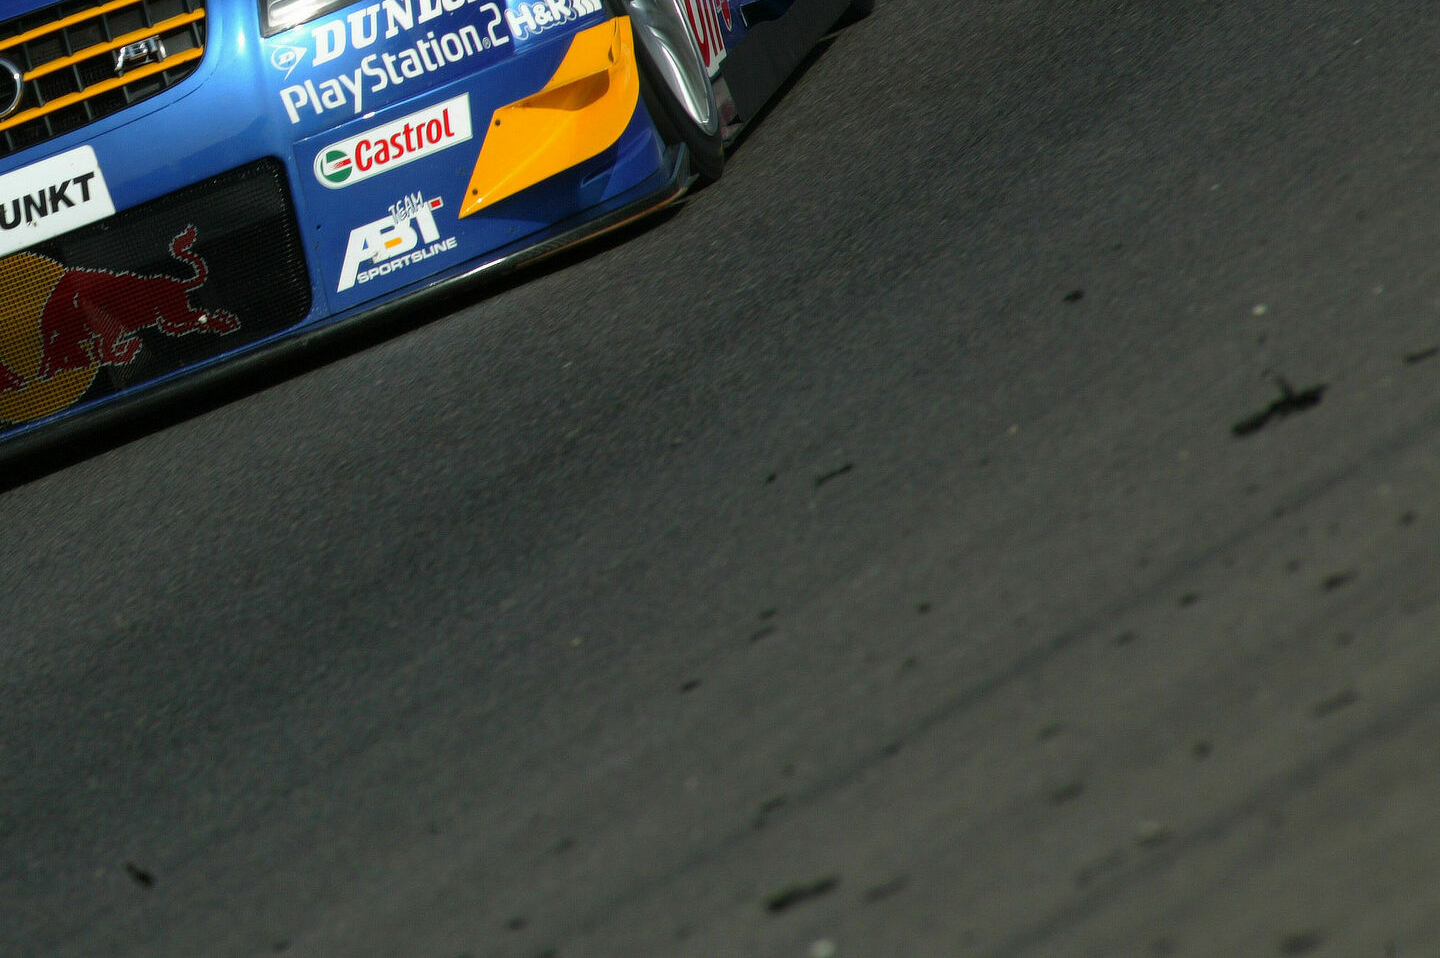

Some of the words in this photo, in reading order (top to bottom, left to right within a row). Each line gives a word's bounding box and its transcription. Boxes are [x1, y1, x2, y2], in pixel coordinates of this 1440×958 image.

[355, 107, 455, 172] Castrol
[388, 190, 424, 223] TEAM
[337, 195, 444, 293] ABT
[357, 236, 458, 284] SPORTSLINE
